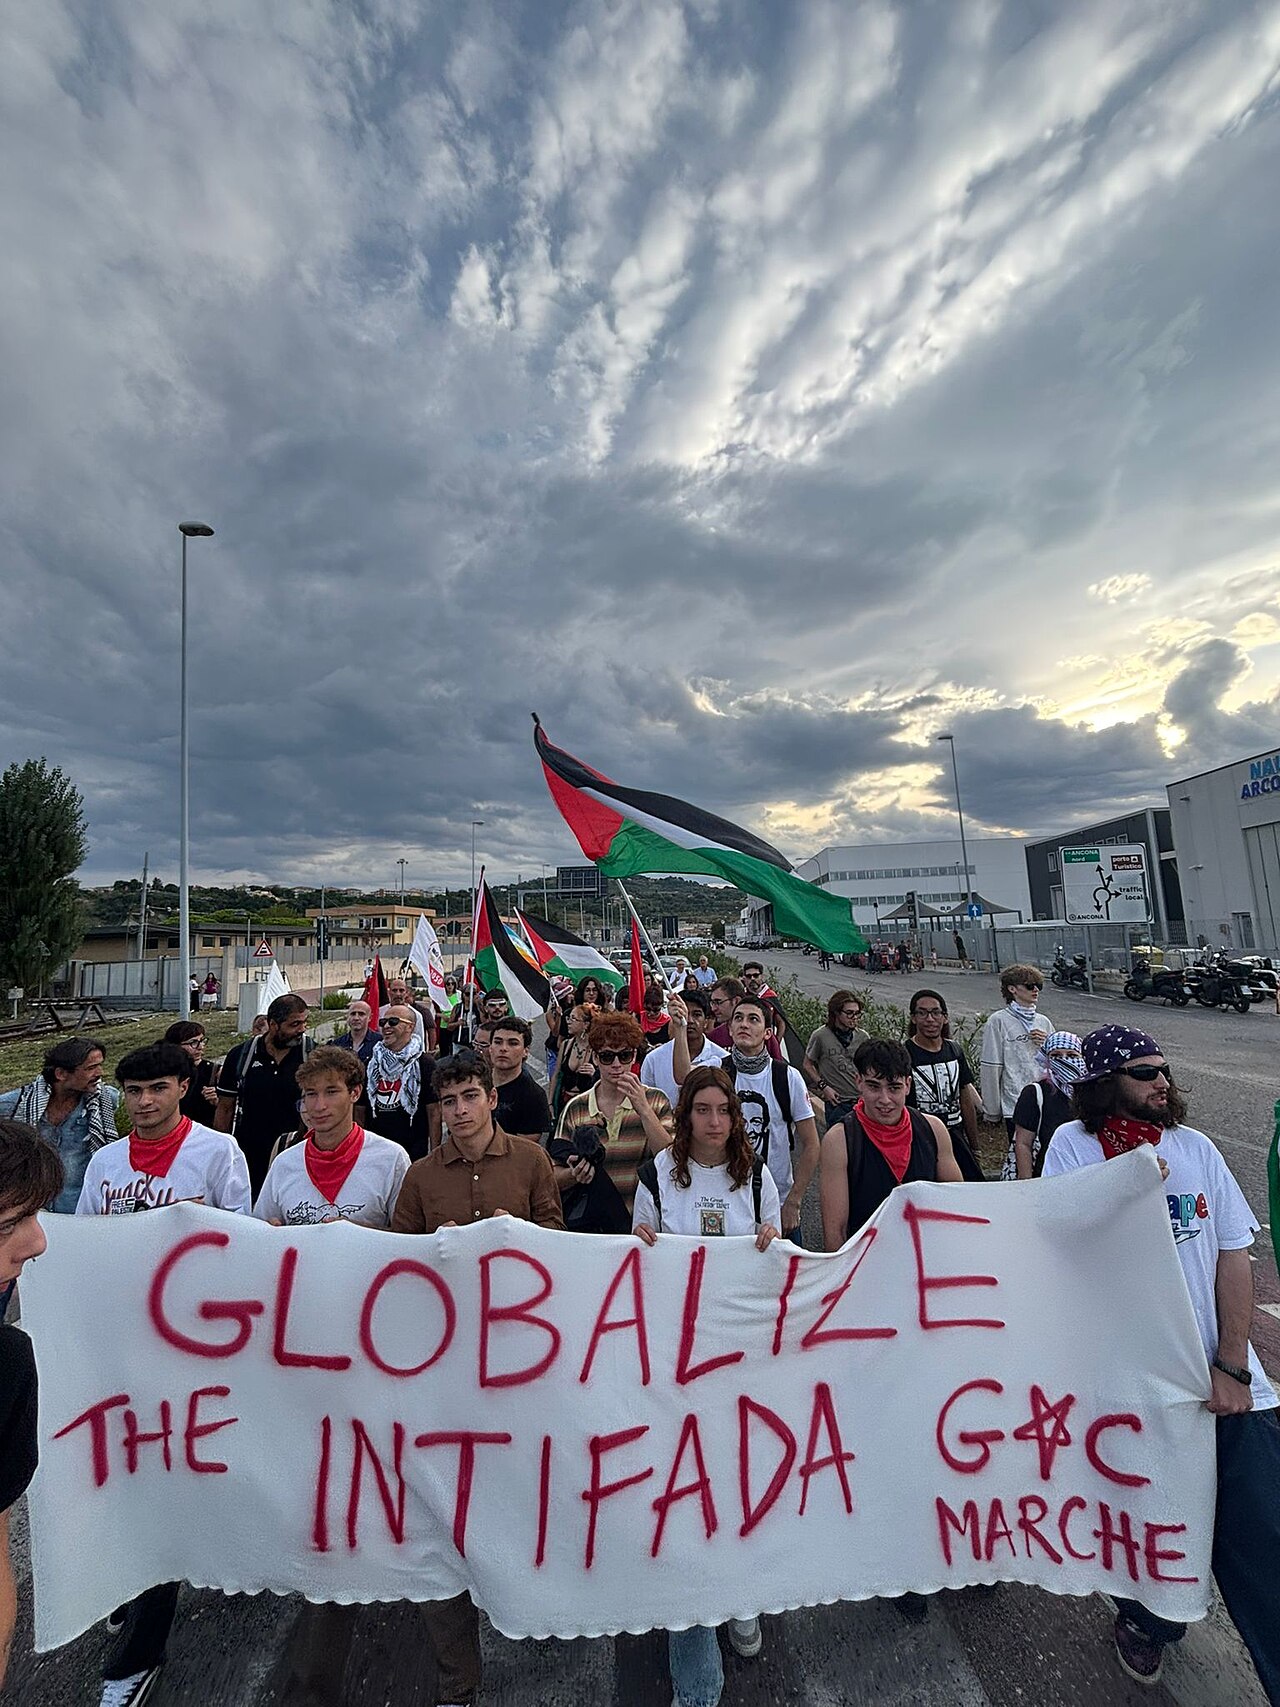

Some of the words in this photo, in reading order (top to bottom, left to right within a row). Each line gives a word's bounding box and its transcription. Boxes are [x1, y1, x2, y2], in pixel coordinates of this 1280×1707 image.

[147, 1200, 1006, 1389] GLOBALIZE
[52, 1386, 239, 1488] THE
[311, 1382, 855, 1570] INTIFADA
[934, 1495, 1200, 1584] MARCHE
